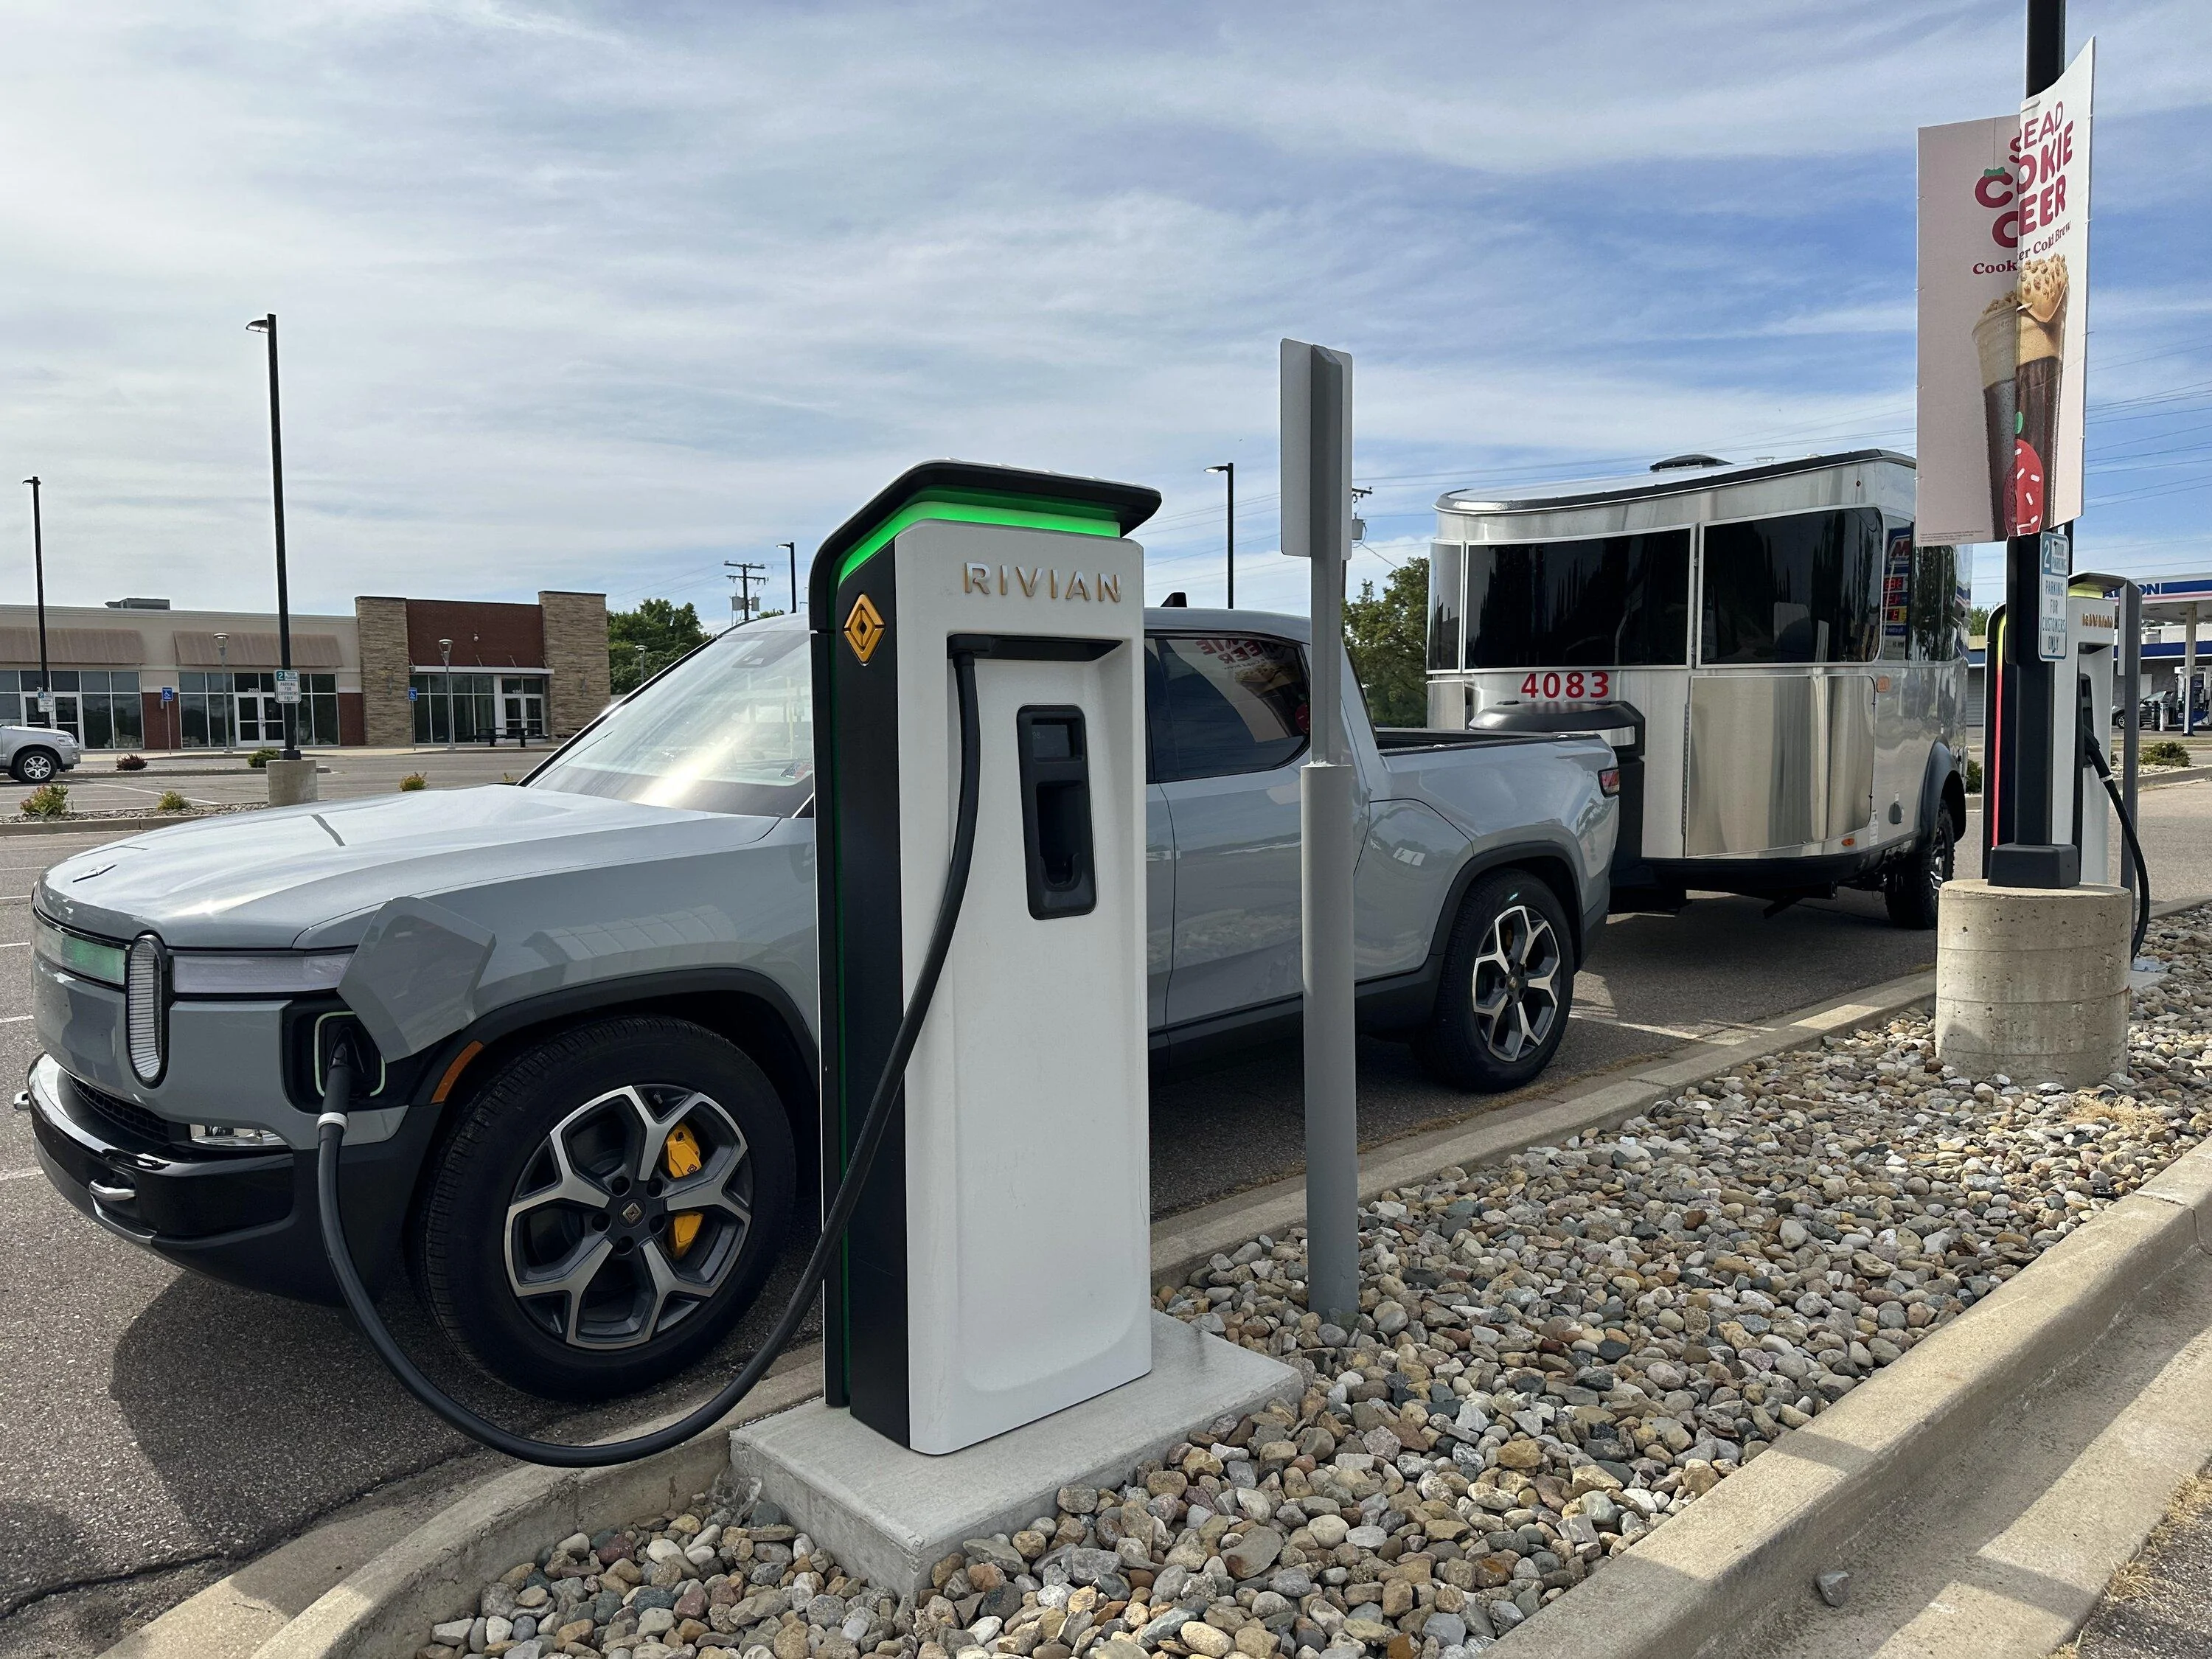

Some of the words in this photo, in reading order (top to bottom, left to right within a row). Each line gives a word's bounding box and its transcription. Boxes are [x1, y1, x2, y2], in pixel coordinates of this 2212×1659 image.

[2033, 232, 2054, 254] Cold
[2044, 540, 2050, 568] 2
[964, 562, 1121, 602] RIVIAN
[278, 672, 283, 680] 2
[1521, 672, 1609, 698] 4083
